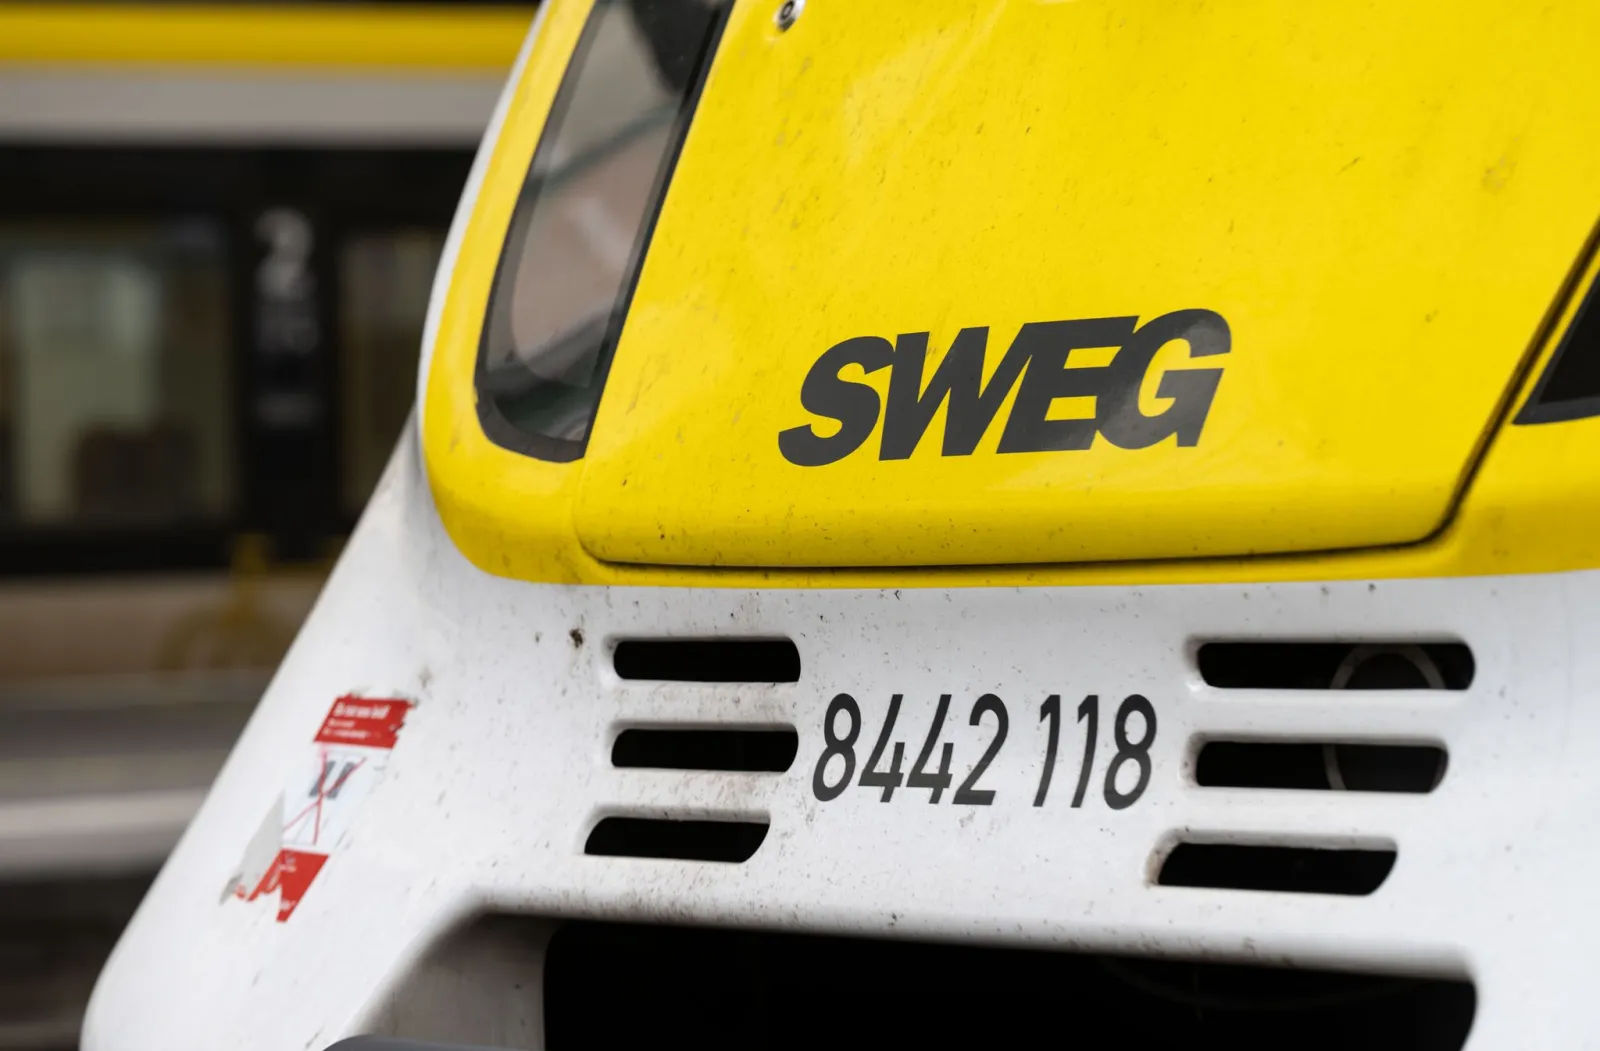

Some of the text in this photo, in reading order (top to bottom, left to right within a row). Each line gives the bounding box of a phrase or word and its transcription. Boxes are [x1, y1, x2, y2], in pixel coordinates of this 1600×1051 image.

[778, 309, 1232, 467] SWEG
[812, 693, 1157, 810] 8442 118
